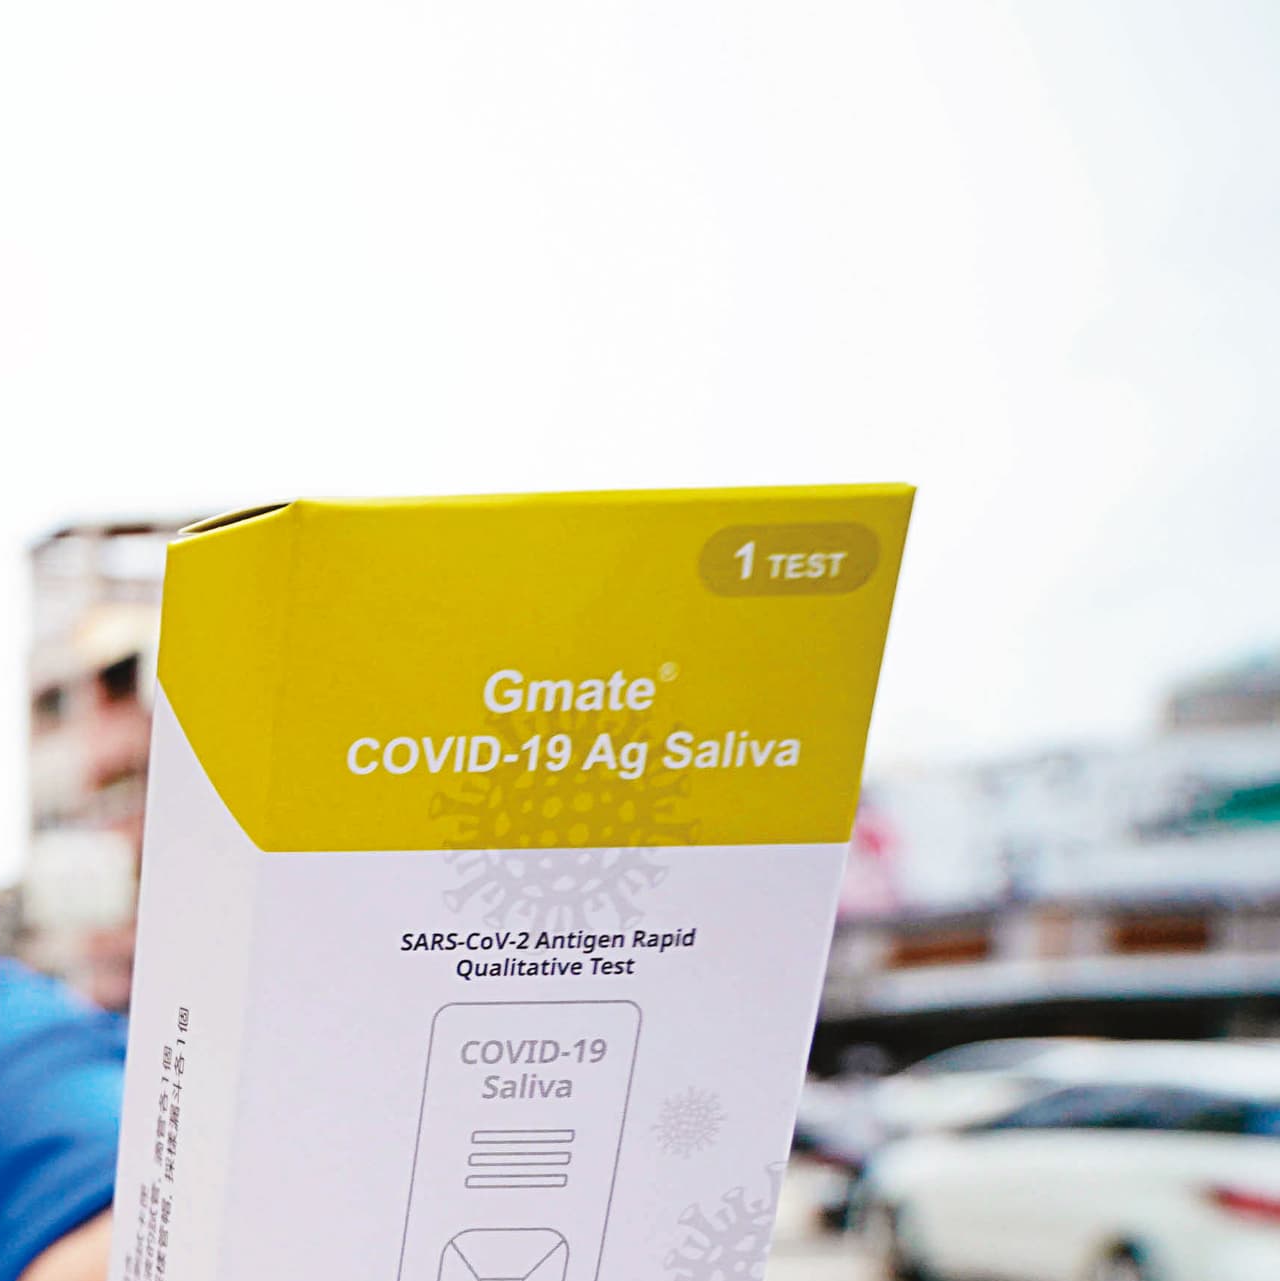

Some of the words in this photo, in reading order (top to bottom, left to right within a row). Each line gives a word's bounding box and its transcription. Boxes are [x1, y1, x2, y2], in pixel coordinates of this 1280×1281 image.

[733, 542, 755, 580] 1
[766, 551, 846, 579] TEST
[347, 733, 572, 776] COVID-19
[583, 731, 647, 780] Ag
[663, 731, 801, 770] Saliva
[400, 931, 530, 951] SARS-CoV-2
[535, 930, 625, 954] Antigen
[631, 928, 697, 953] Rapid
[456, 957, 583, 981] Qualitative
[590, 957, 635, 976] Test
[460, 1038, 608, 1065] COVID-19
[481, 1073, 574, 1099] Saliva
